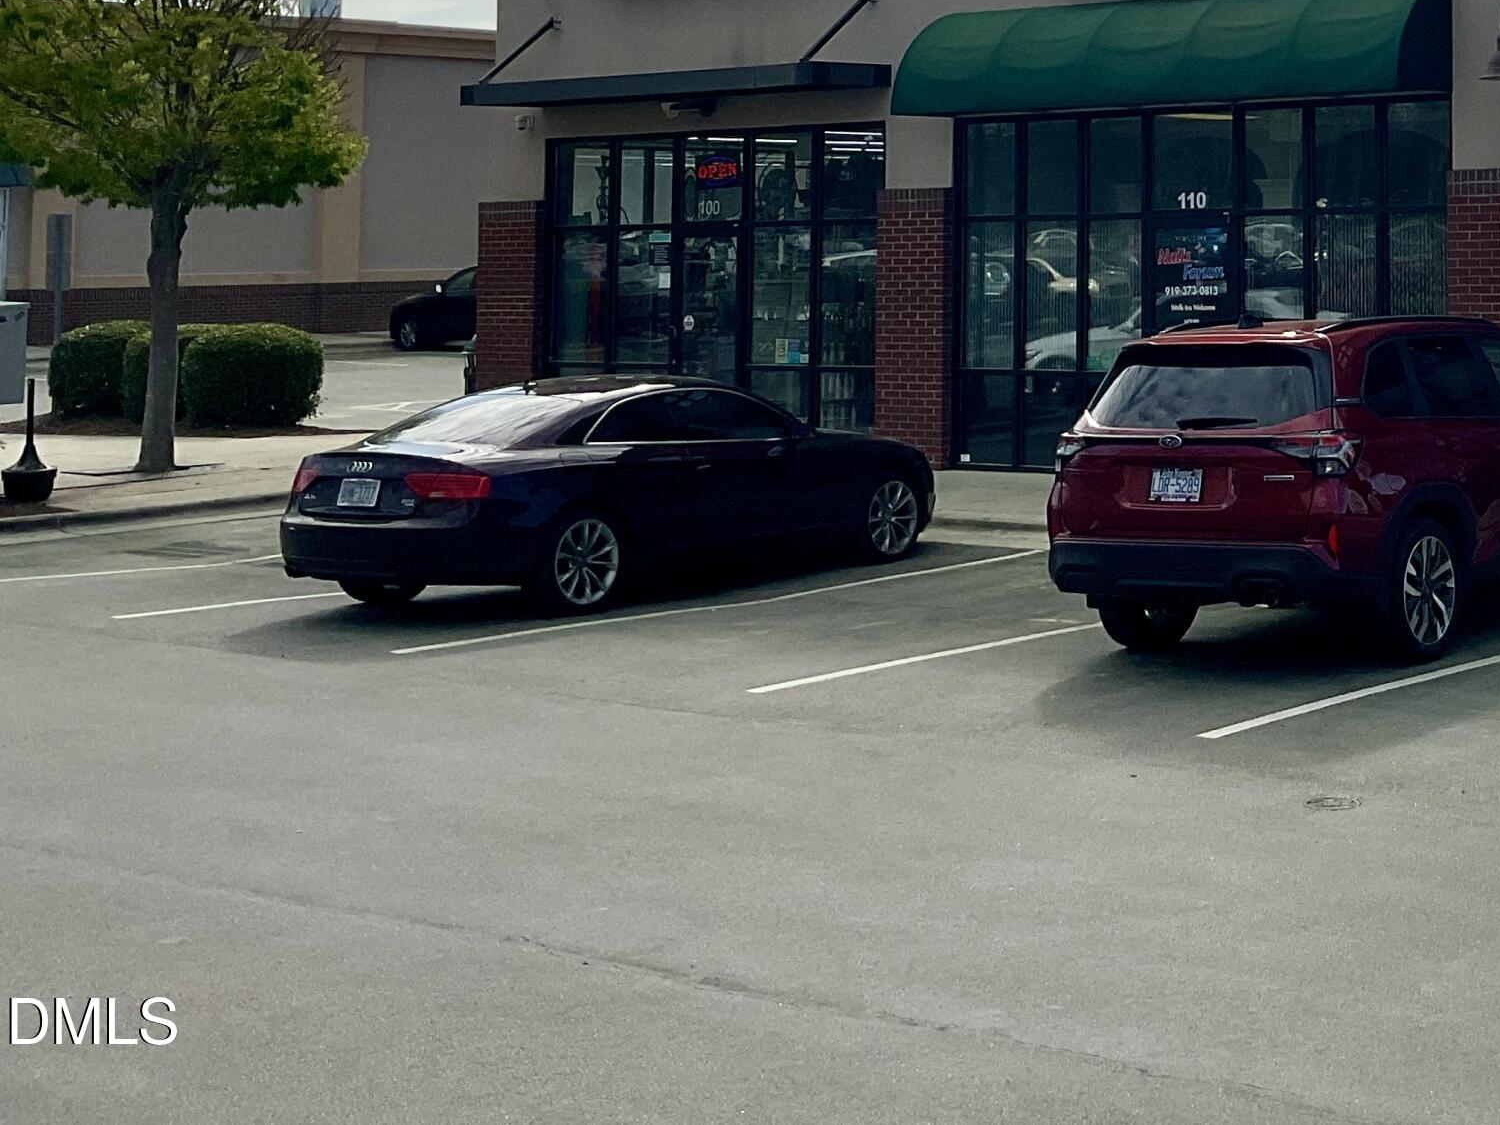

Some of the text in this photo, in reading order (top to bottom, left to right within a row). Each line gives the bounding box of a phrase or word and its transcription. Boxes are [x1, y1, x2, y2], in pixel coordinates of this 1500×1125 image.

[696, 161, 737, 180] OPEN
[700, 200, 720, 215] 100
[1177, 191, 1207, 209] 110
[1157, 247, 1192, 265] Nails
